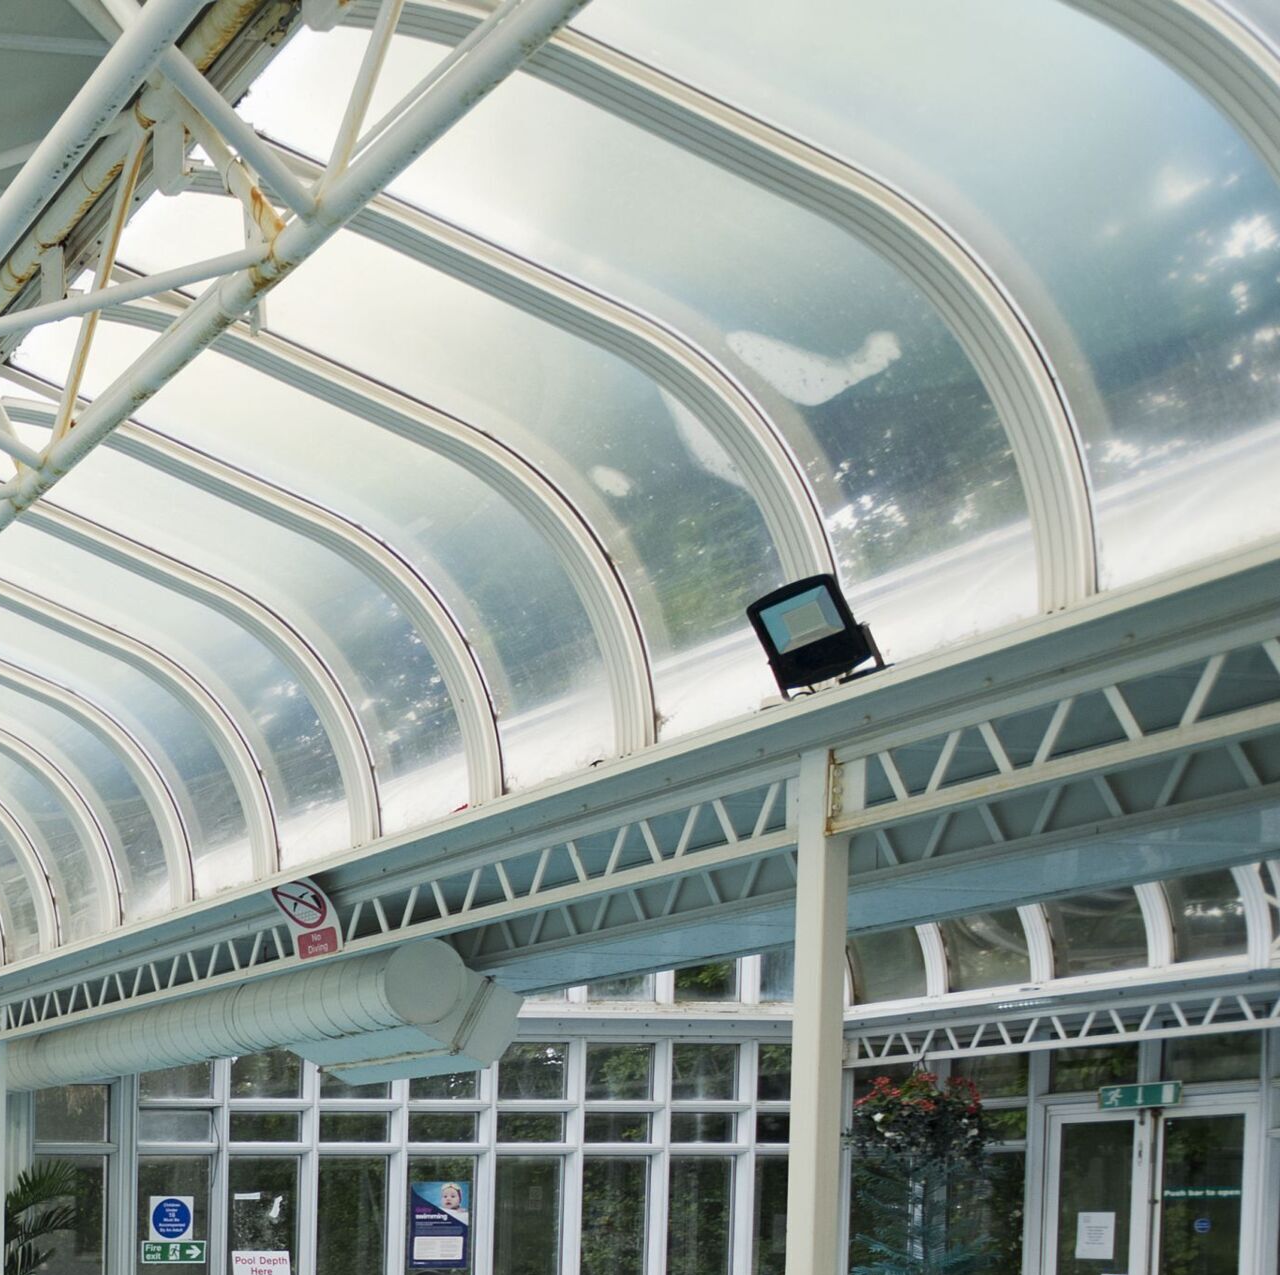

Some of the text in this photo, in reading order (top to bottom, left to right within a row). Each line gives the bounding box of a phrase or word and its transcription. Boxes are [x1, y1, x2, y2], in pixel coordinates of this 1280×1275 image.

[312, 933, 322, 942] No
[308, 943, 328, 954] Diving
[415, 1213, 448, 1221] swimming
[144, 1244, 162, 1252] Fire
[144, 1252, 162, 1261] exit
[235, 1256, 288, 1266] Pool Depth
[251, 1268, 272, 1275] Here
